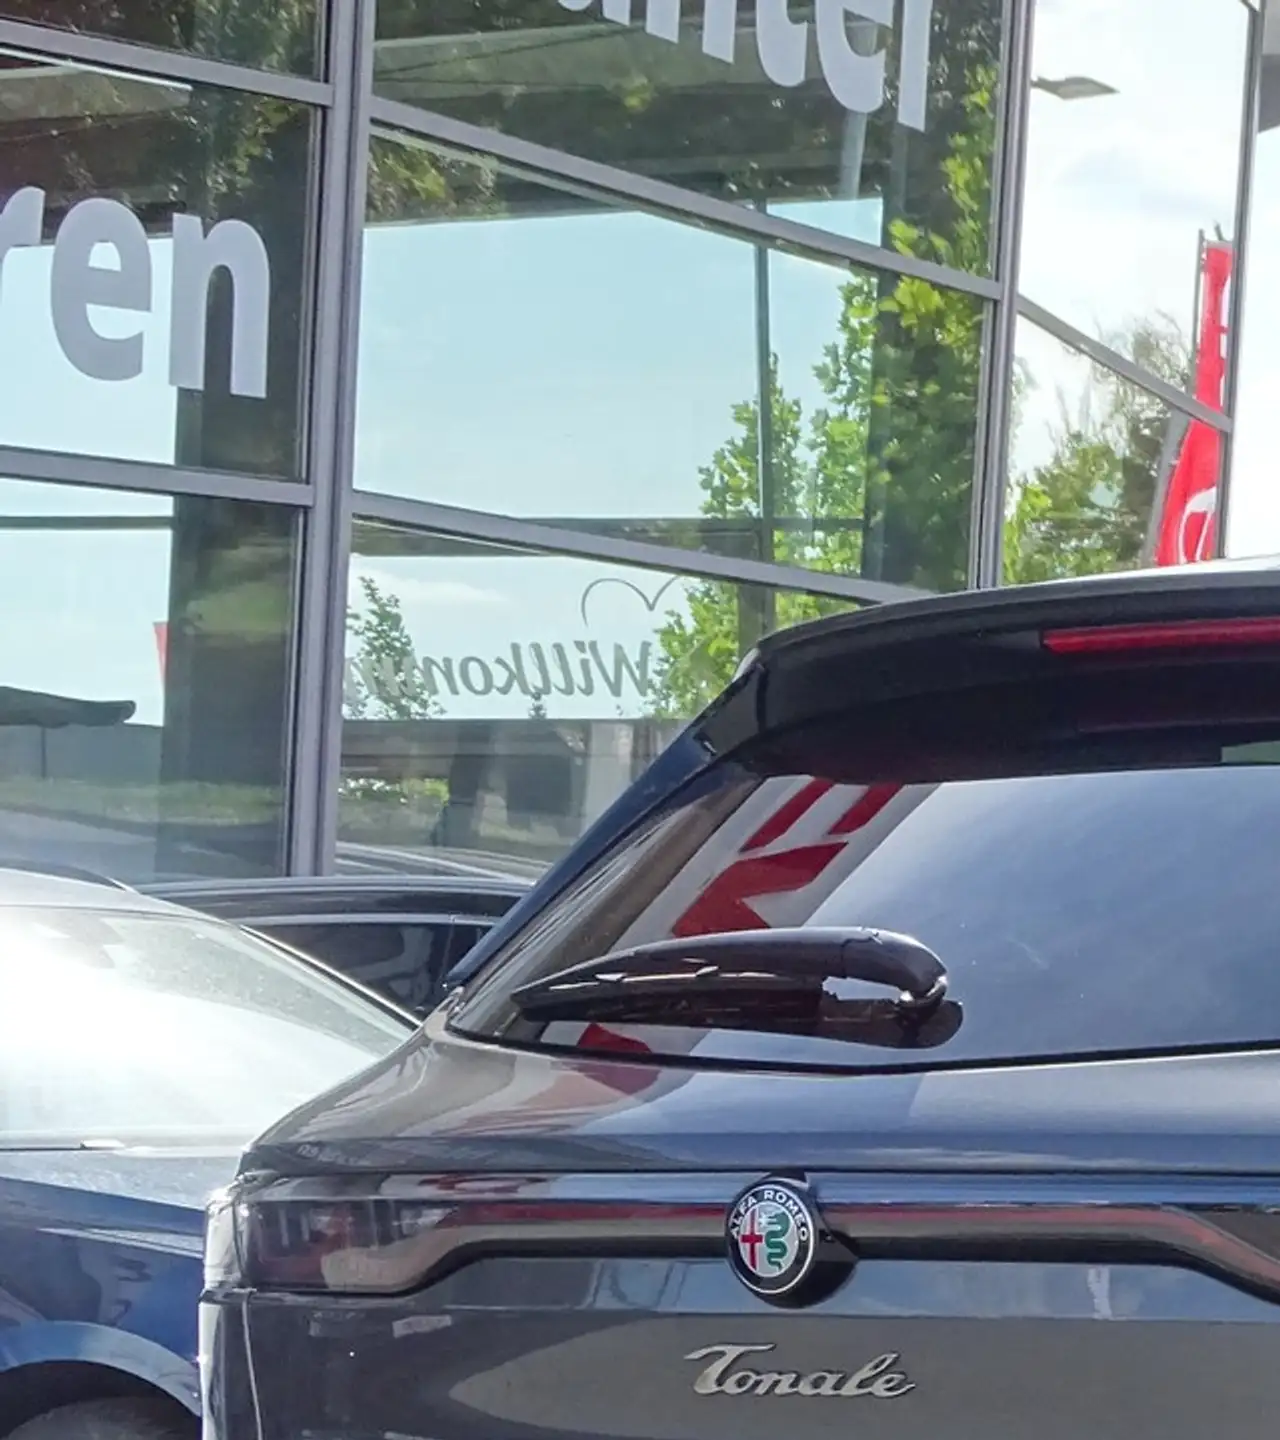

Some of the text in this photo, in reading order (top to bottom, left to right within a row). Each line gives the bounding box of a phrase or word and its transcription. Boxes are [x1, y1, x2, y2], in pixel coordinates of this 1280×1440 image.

[731, 1189, 809, 1241] ALFA ROMEO
[682, 1342, 917, 1398] Tonale
